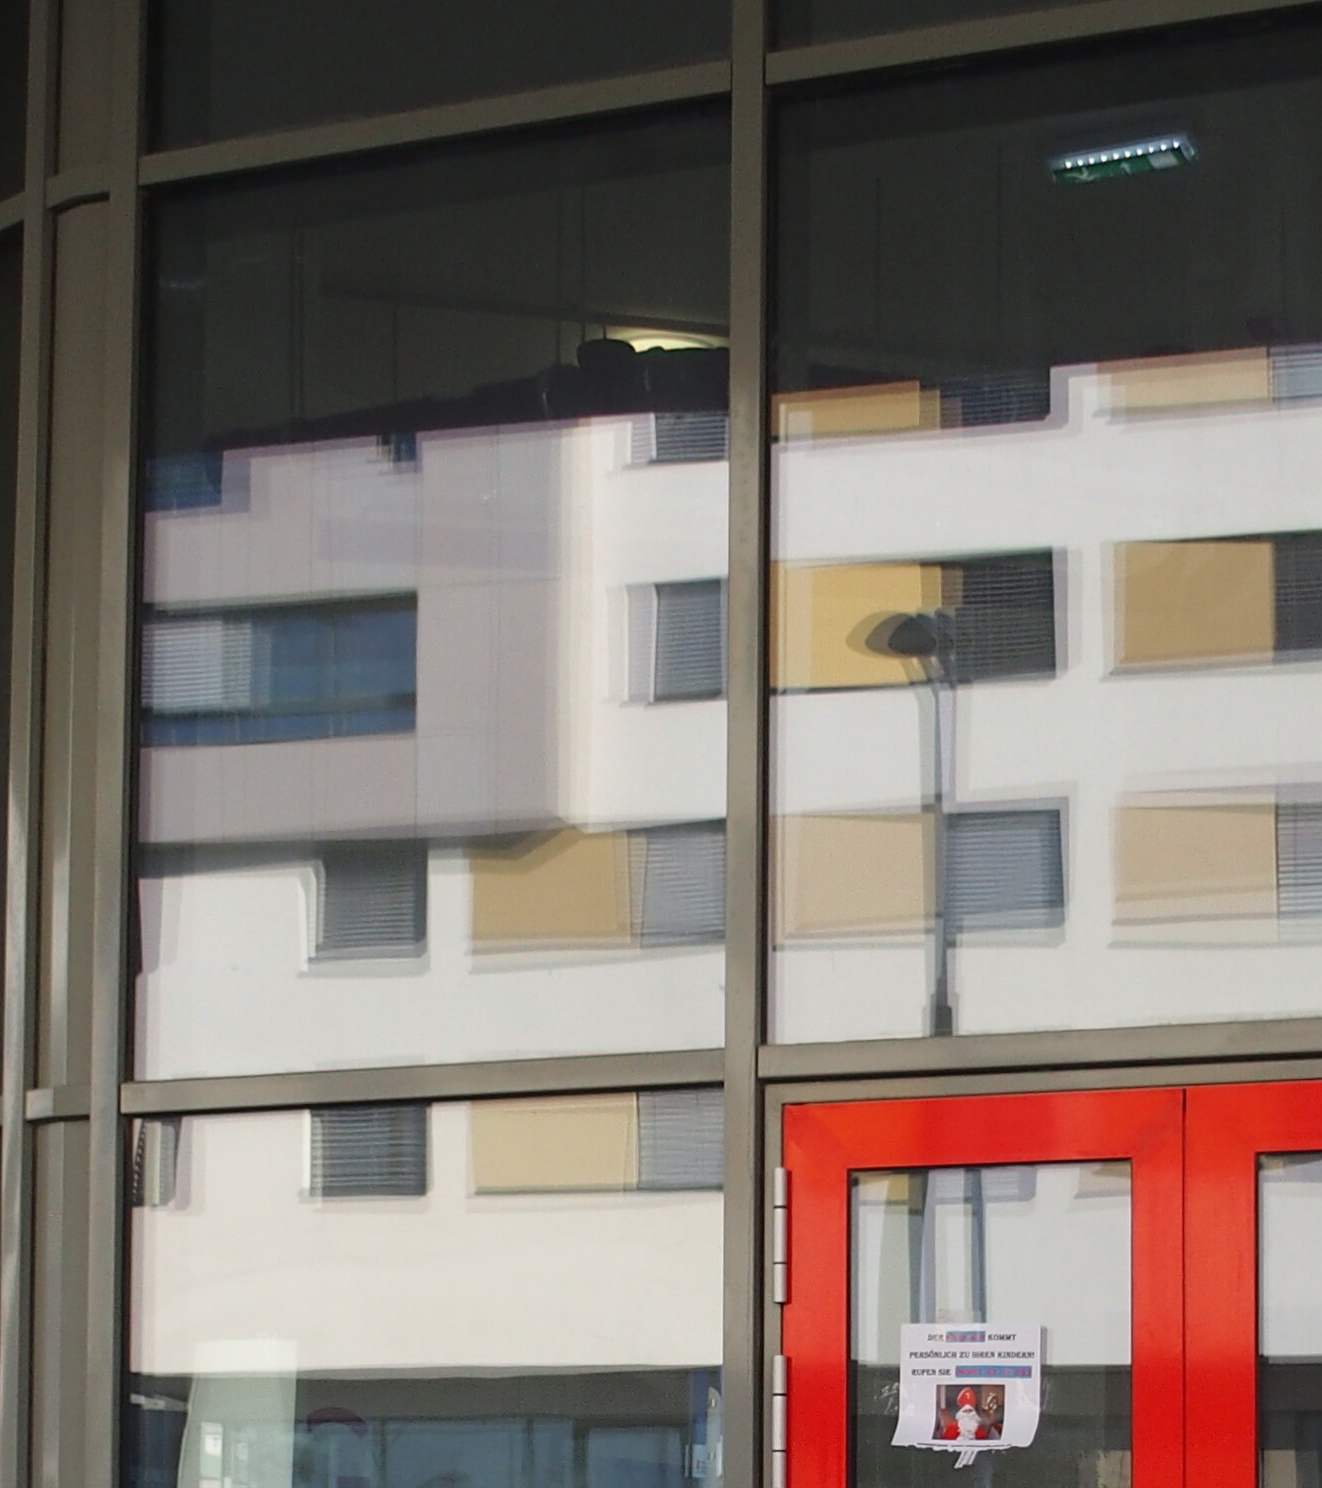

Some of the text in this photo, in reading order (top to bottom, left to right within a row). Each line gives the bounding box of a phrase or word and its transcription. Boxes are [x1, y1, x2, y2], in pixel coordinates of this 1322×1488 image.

[987, 1333, 1017, 1341] KOMMT
[909, 1350, 957, 1359] PERSÖNLICH
[959, 1351, 969, 1359] ZU
